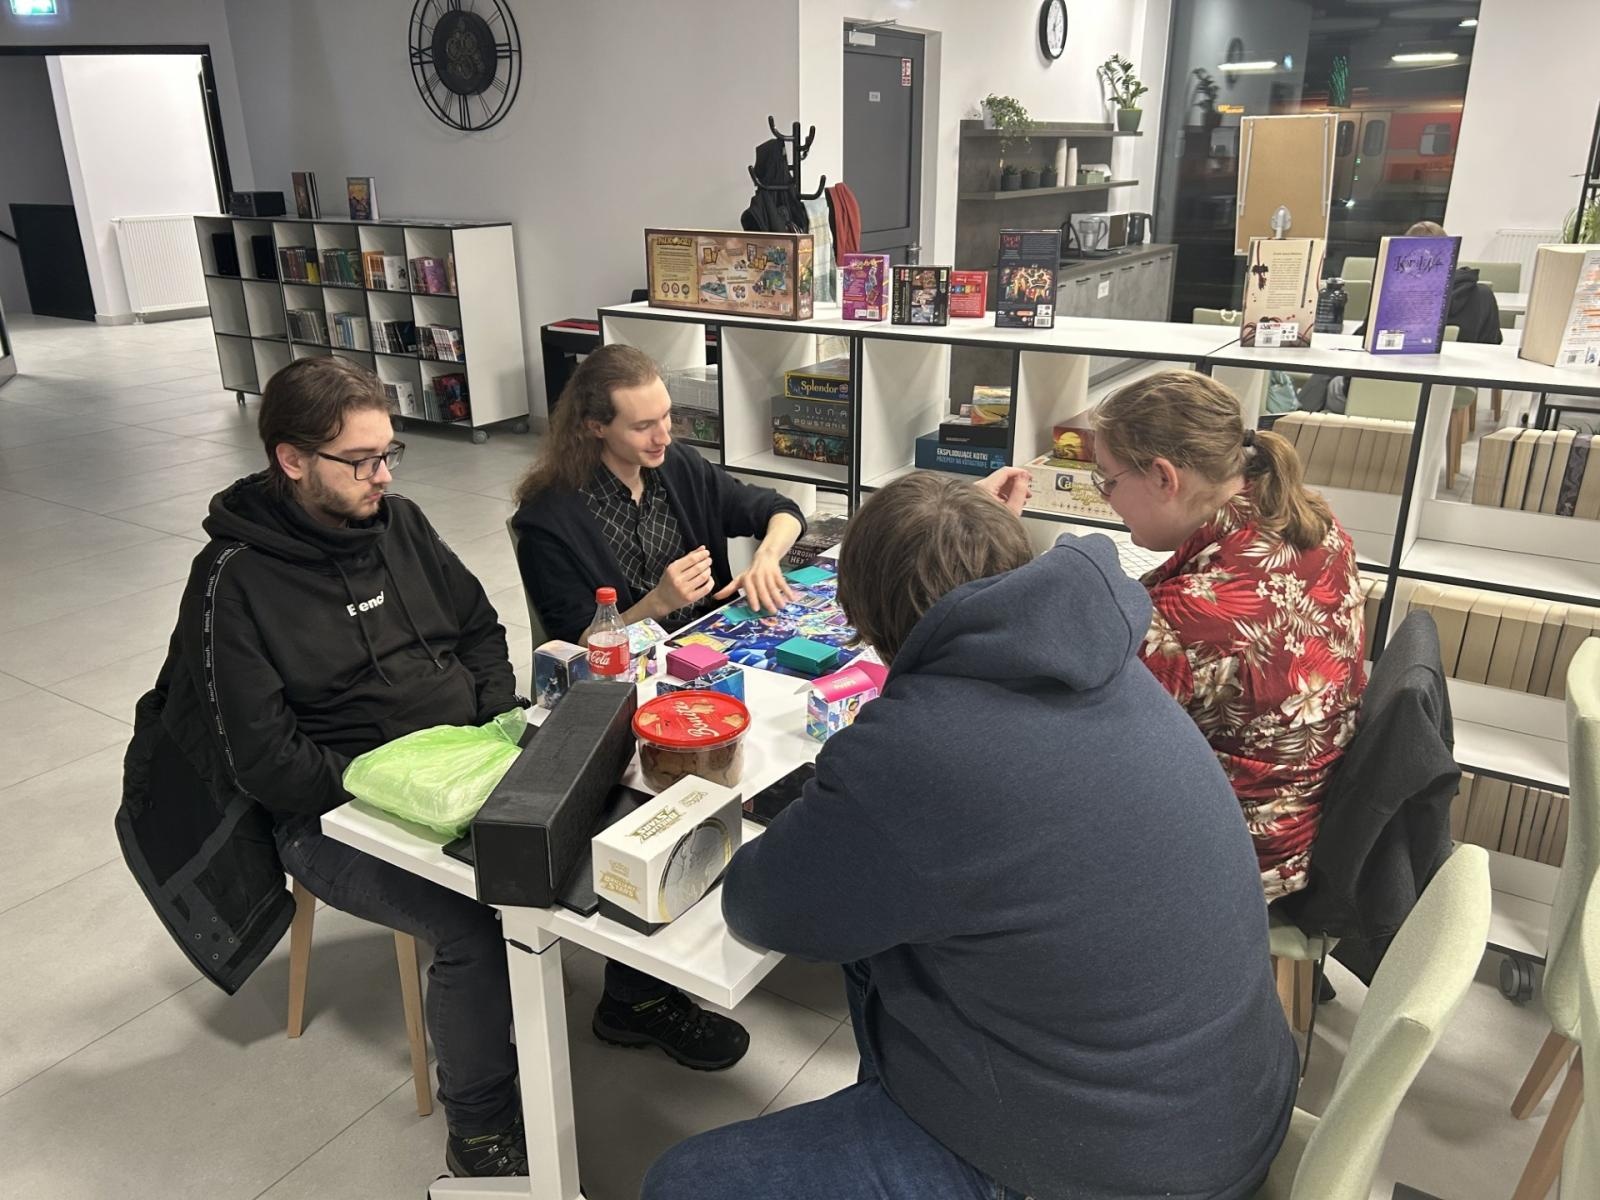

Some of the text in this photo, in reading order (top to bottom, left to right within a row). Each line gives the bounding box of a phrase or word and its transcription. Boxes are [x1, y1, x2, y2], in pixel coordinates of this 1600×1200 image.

[801, 379, 838, 395] Splendor
[793, 418, 847, 430] POWSTANIE
[590, 650, 613, 666] Cola
